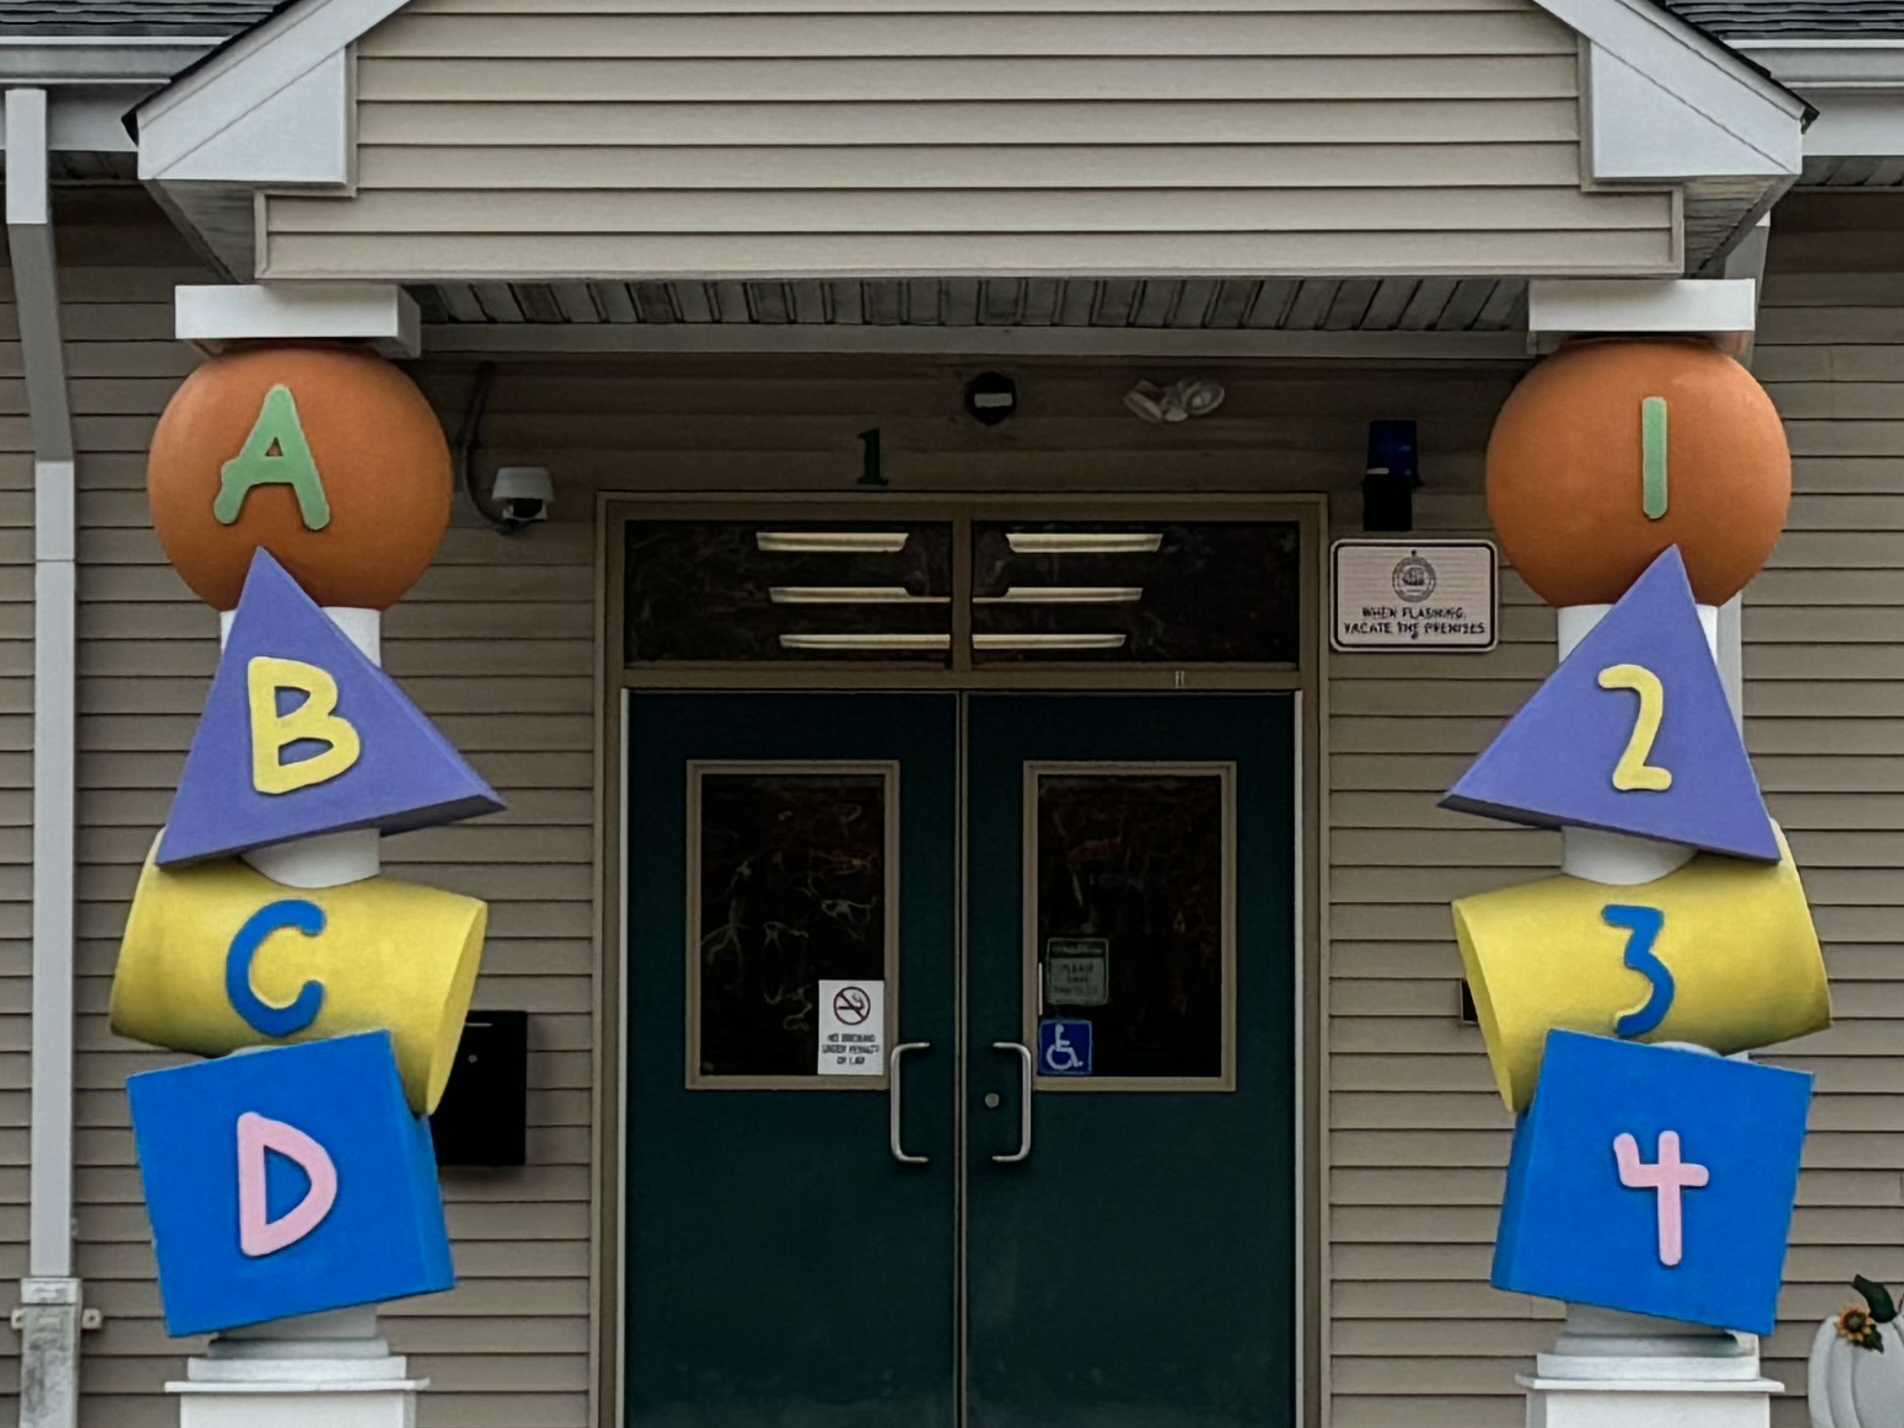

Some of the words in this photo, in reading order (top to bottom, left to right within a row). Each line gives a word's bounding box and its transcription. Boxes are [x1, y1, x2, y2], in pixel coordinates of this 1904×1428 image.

[213, 384, 331, 530] A
[857, 427, 890, 486] 1
[1344, 622, 1392, 634] VACATE
[1397, 622, 1419, 634] THE
[1424, 622, 1486, 634] PREMISES
[1362, 606, 1396, 619] WHEN
[248, 656, 361, 795] B
[1598, 664, 1673, 791] 2
[226, 899, 327, 1038] C
[1601, 903, 1676, 1037] 3
[237, 1111, 338, 1258] D
[1613, 1130, 1710, 1267] 4
